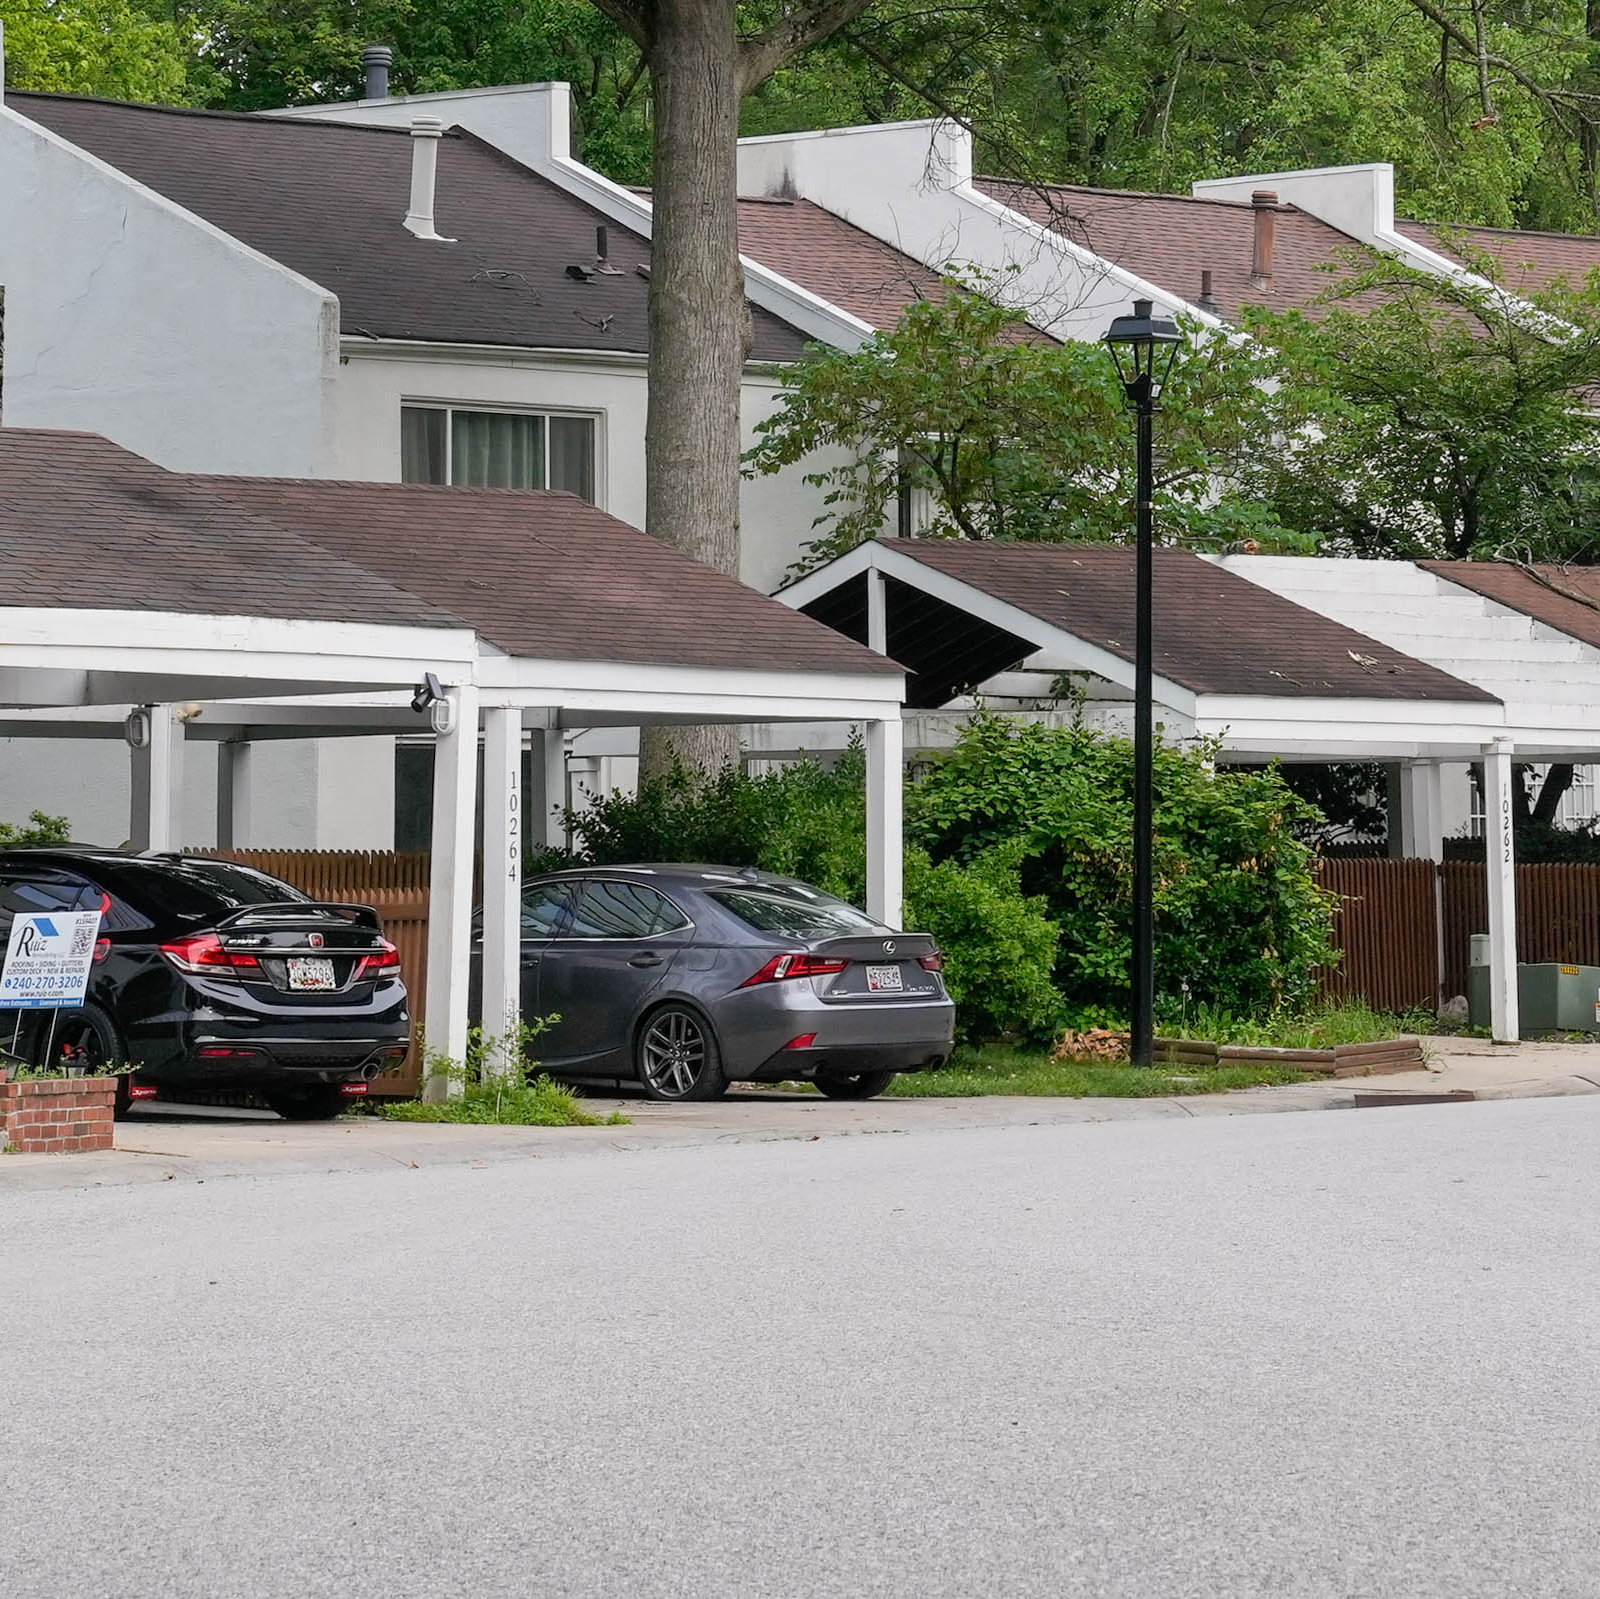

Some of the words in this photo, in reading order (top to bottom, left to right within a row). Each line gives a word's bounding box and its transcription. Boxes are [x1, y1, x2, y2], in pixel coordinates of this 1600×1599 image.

[508, 771, 518, 882] 10264
[1502, 782, 1510, 863] 10262
[15, 926, 48, 958] Ruiz
[6, 968, 29, 976] CUSTOM
[65, 966, 86, 974] REPAIRS
[12, 976, 83, 989] 240-270-3206
